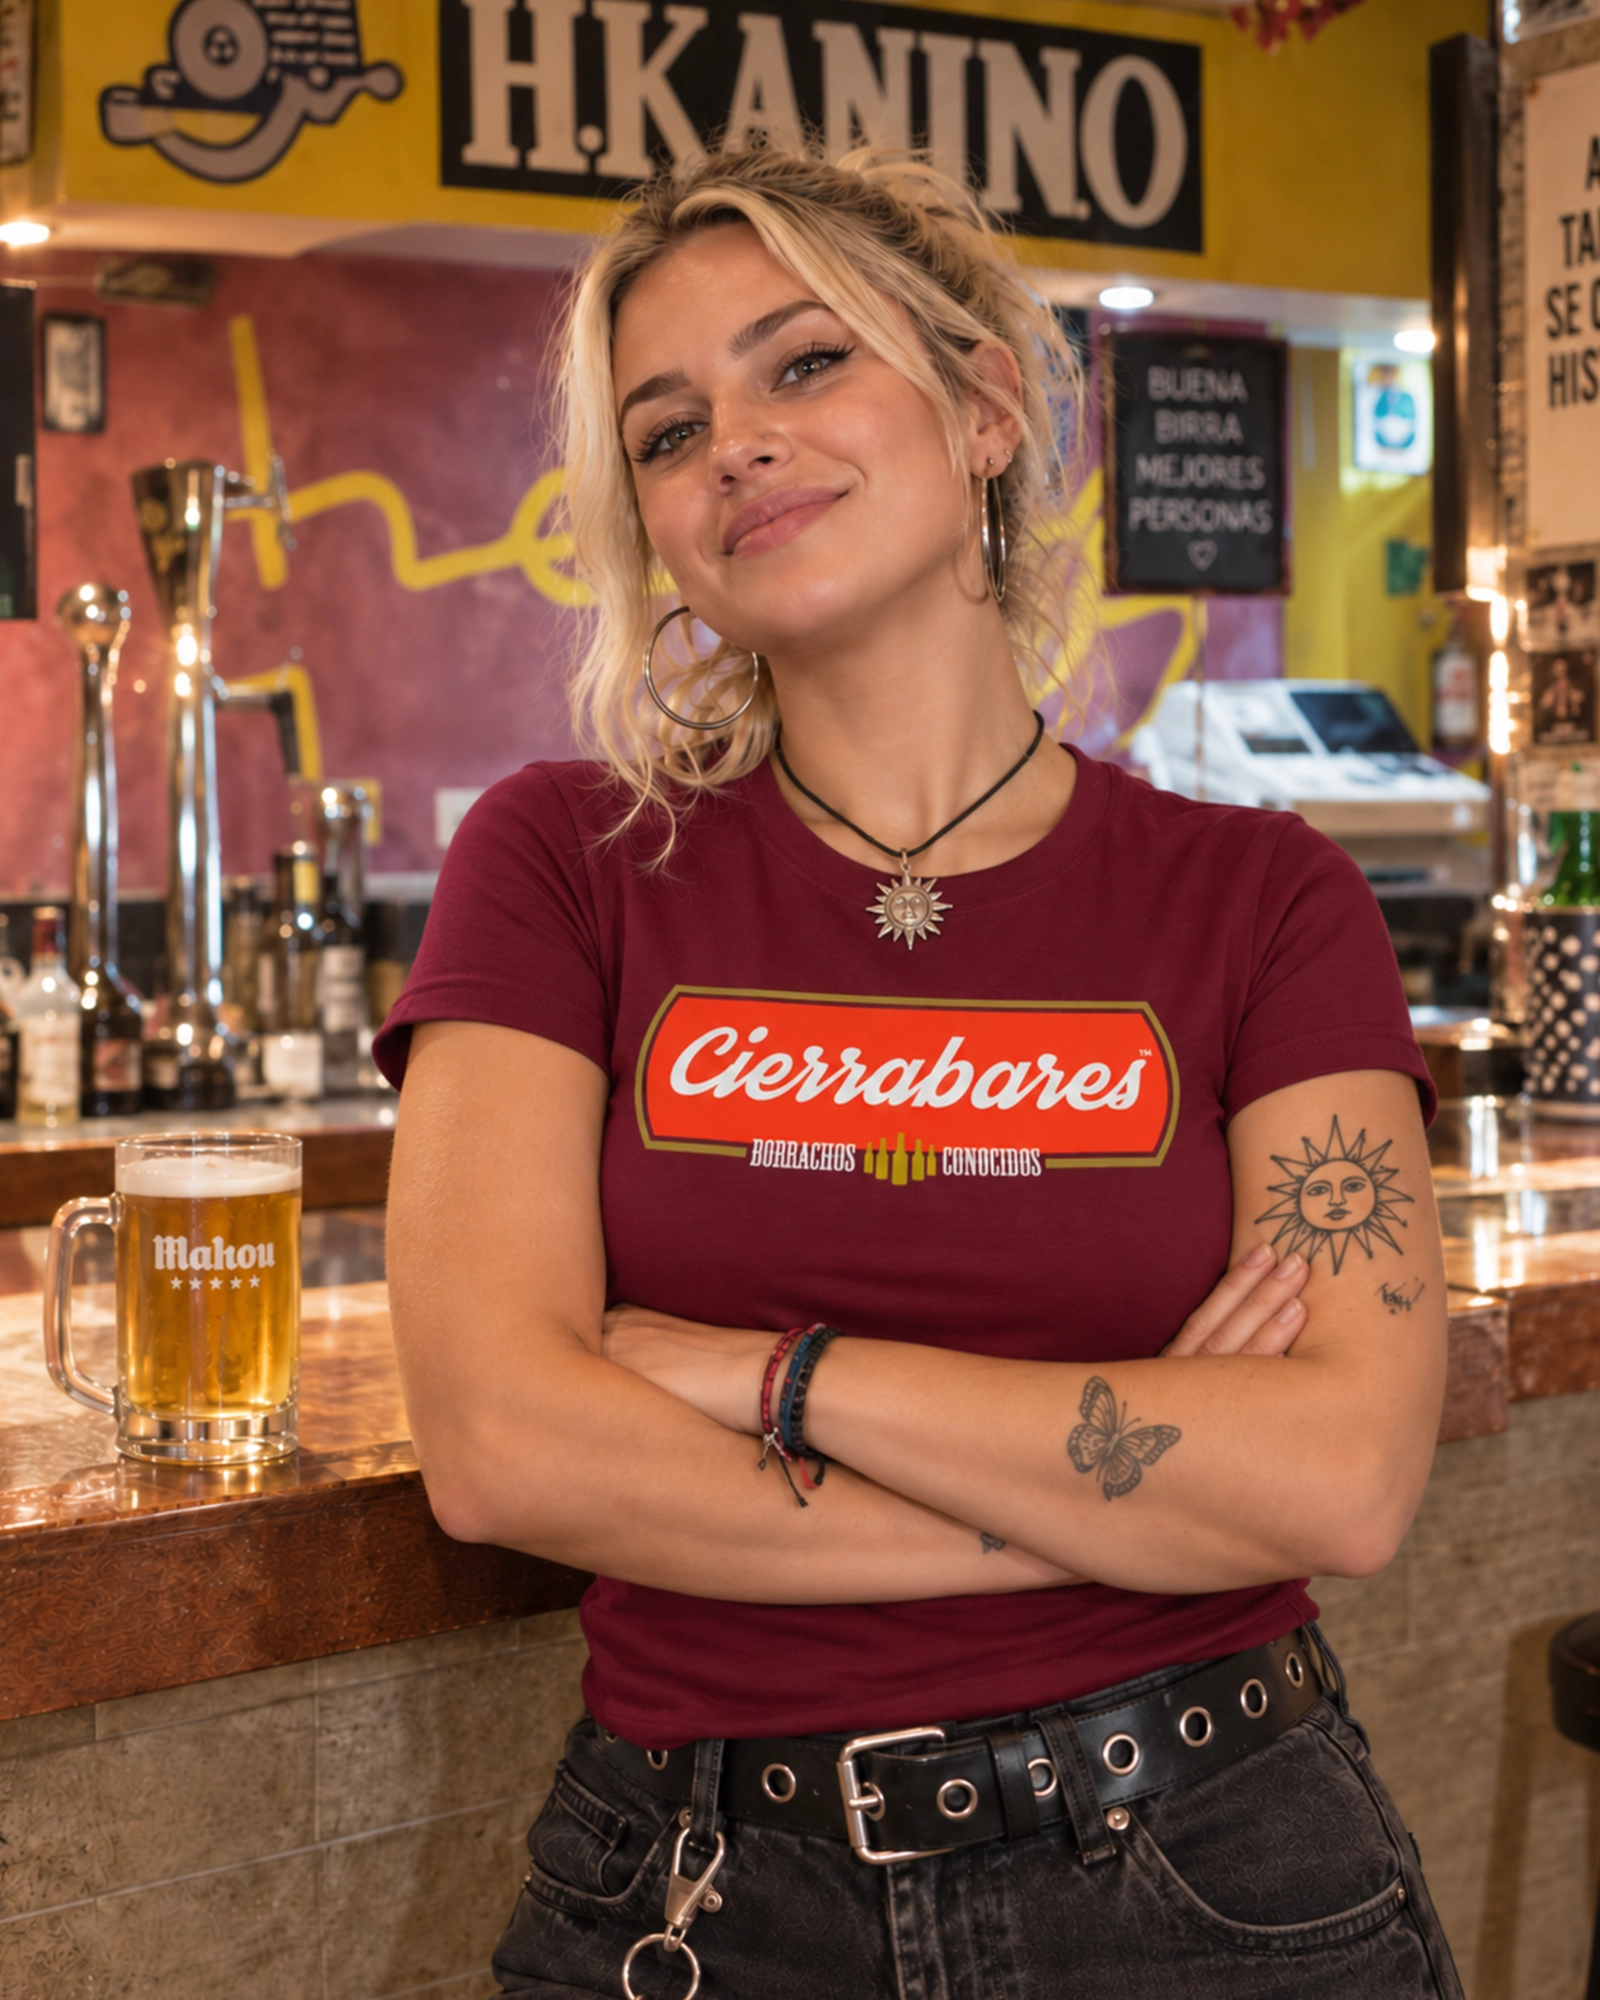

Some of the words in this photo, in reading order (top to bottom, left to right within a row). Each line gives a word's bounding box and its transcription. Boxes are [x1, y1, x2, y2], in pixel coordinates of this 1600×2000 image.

[1559, 207, 1600, 270] TA
[1545, 284, 1581, 340] SE
[1147, 365, 1248, 403] BUENA
[1548, 346, 1600, 410] HIS
[1155, 409, 1243, 445] BIRRA
[1136, 453, 1266, 491] MEJORES
[1129, 496, 1273, 534] PERSONAS
[669, 1026, 1147, 1111] Cierrabares
[749, 1138, 857, 1172] BORRACHOS
[942, 1146, 1042, 1177] CONOCIDOS
[152, 1234, 276, 1271] Mahou
